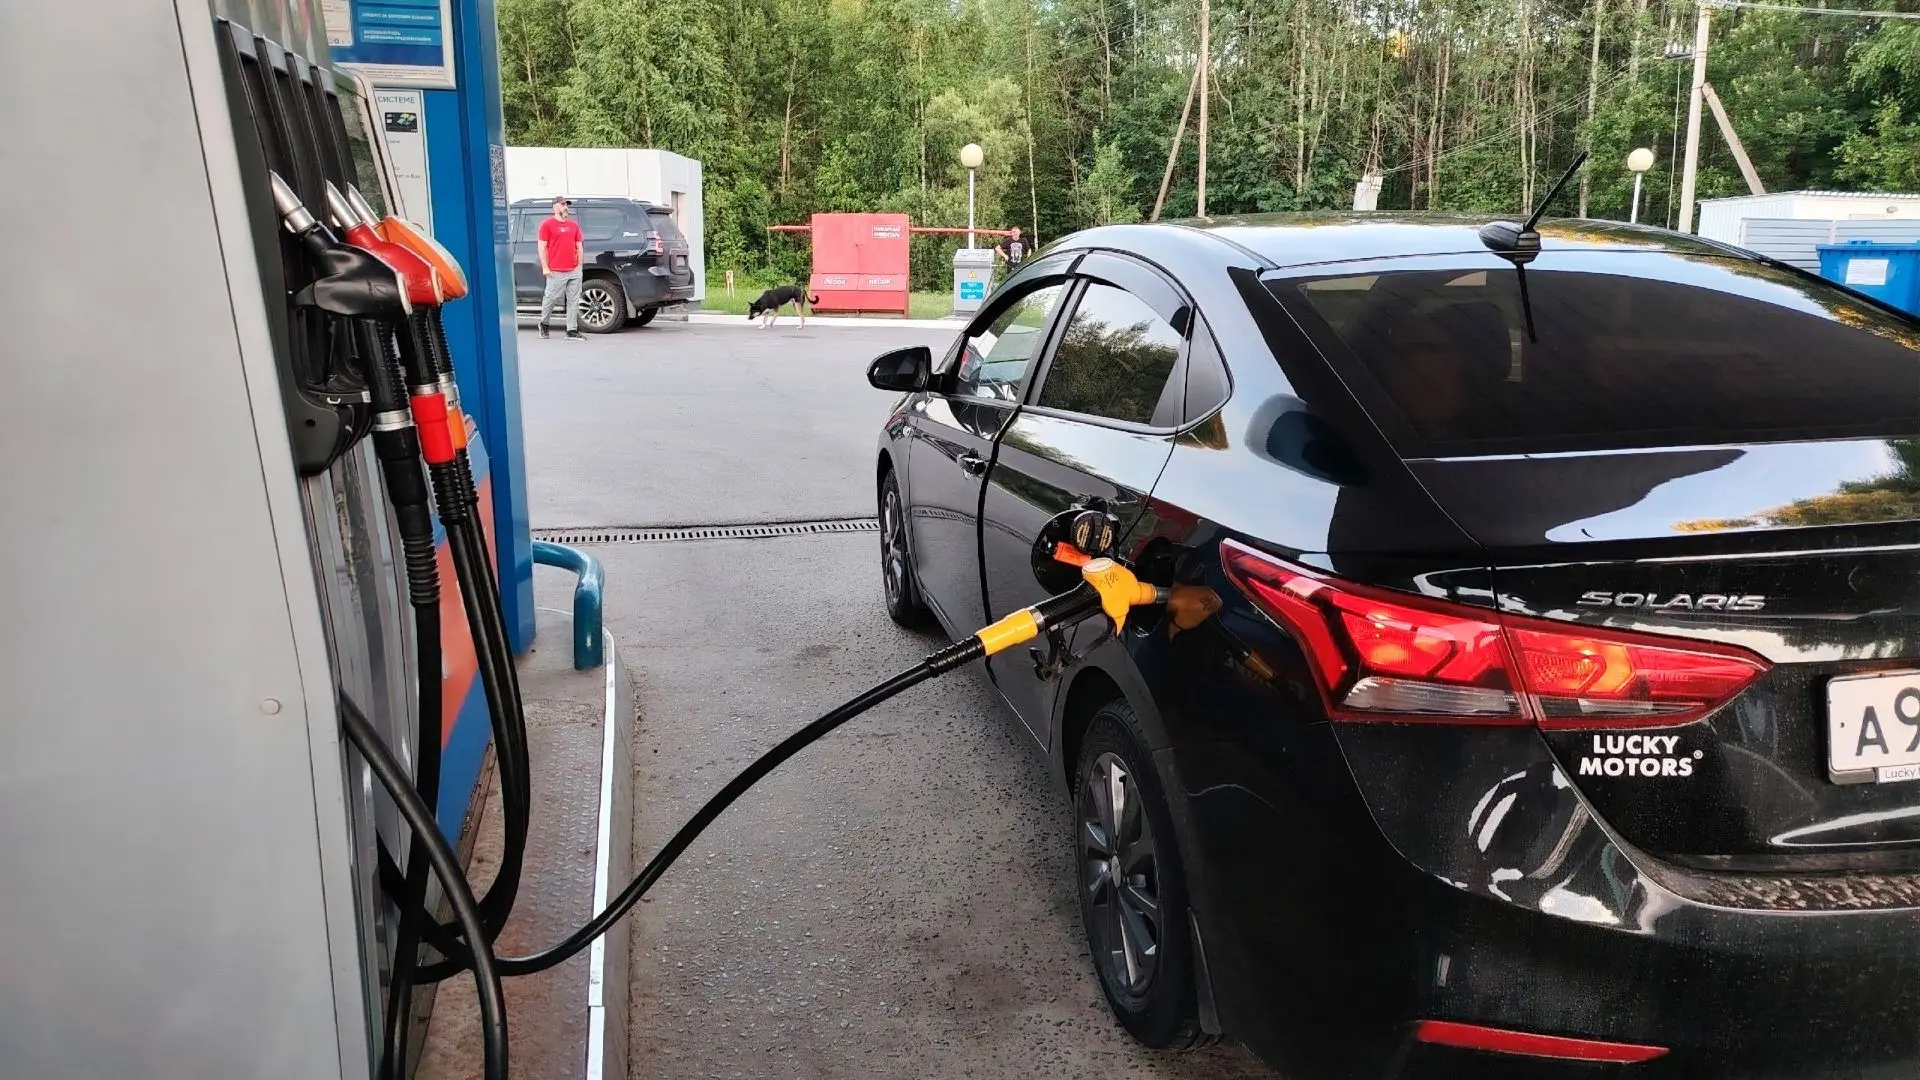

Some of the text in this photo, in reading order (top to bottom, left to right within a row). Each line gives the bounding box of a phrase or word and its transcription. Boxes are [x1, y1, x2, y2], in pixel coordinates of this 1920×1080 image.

[377, 96, 415, 104] СИСТЕМЕ
[1576, 591, 1766, 611] SOLARIS
[1593, 735, 1680, 755] LUCKY
[1885, 767, 1916, 779] Lucky
